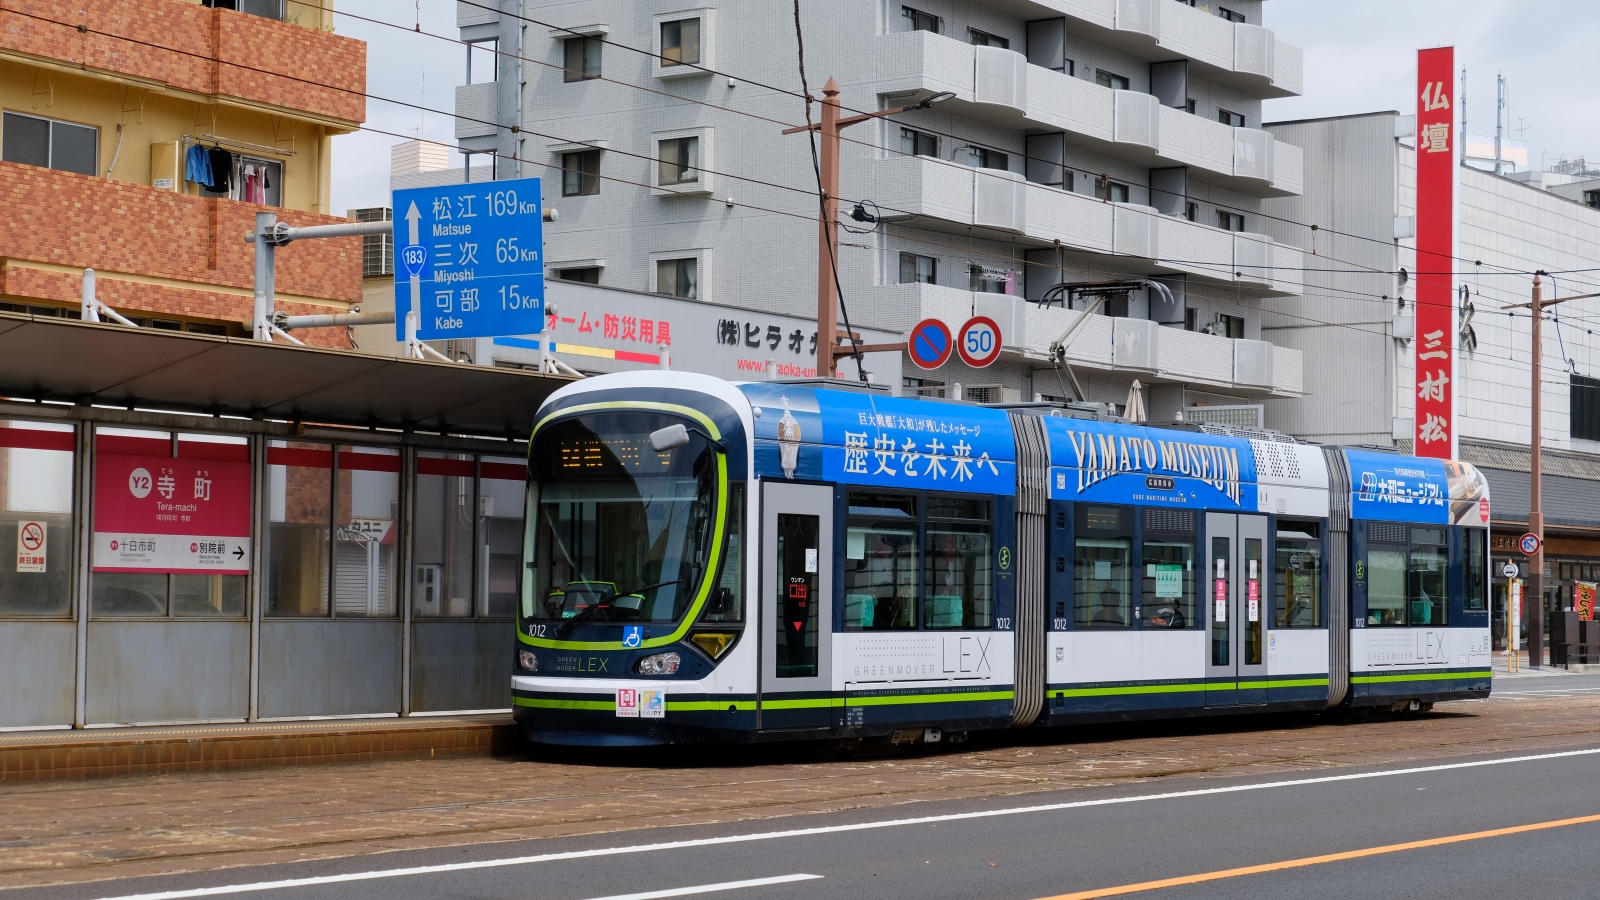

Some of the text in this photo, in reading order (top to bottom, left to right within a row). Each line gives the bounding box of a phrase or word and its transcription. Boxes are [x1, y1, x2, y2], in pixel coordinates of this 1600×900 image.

[1421, 81, 1450, 154] 仏壇
[432, 194, 478, 222] 松江
[432, 223, 472, 237] Matsue
[405, 249, 423, 265] 183
[434, 241, 478, 267] 三次
[433, 268, 475, 285] Miyoshi
[434, 288, 480, 313] 可部
[435, 316, 463, 330] Kabe
[967, 330, 992, 353] 50
[1418, 329, 1450, 445] 三村松
[843, 429, 999, 483] 歴史を未来へ
[1067, 430, 1241, 507] YAMATO MUSEUM
[132, 475, 212, 501] Y2 寺町
[1377, 477, 1444, 507] 大和ミュージアム
[156, 502, 197, 512] Tera-machi
[120, 540, 156, 553] 十日市町
[199, 543, 225, 554] 別院前
[529, 624, 546, 637] 1012
[996, 617, 1011, 629] 1012
[1054, 618, 1067, 630] 1012
[1355, 618, 1365, 628] 1012
[942, 636, 992, 674] LEX
[1416, 632, 1445, 659] LEX
[578, 657, 609, 672] LEX
